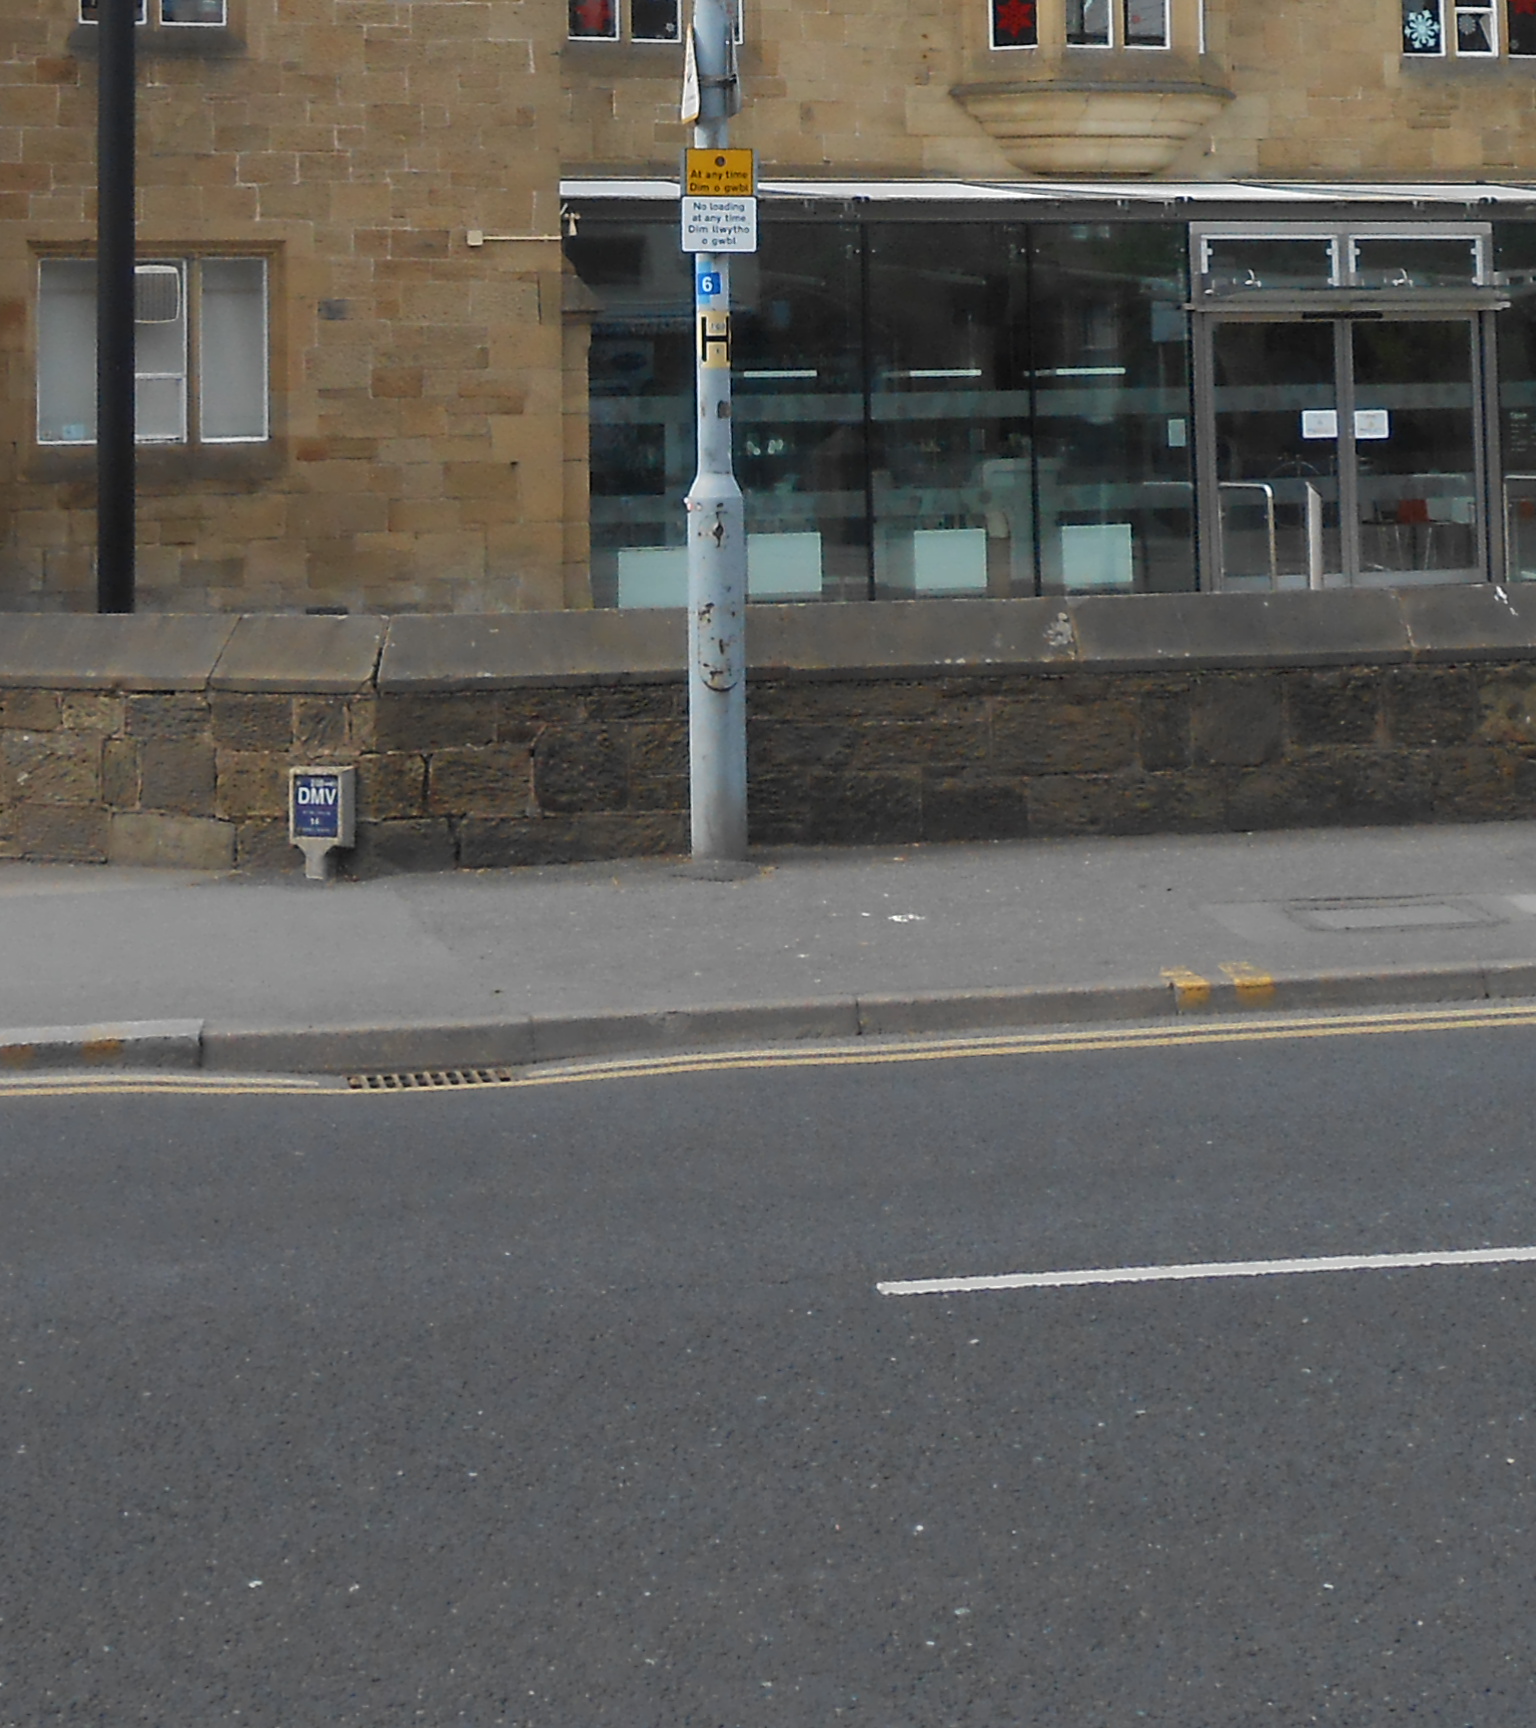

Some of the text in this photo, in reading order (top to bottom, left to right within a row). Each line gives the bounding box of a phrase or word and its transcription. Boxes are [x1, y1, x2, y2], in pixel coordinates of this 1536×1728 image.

[691, 170, 748, 180] At any time
[689, 183, 709, 192] Dim
[693, 202, 745, 212] No loading
[692, 214, 746, 223] at any time
[688, 225, 750, 235] Dim llwytho
[702, 276, 713, 292] 6
[297, 787, 337, 805] DMV
